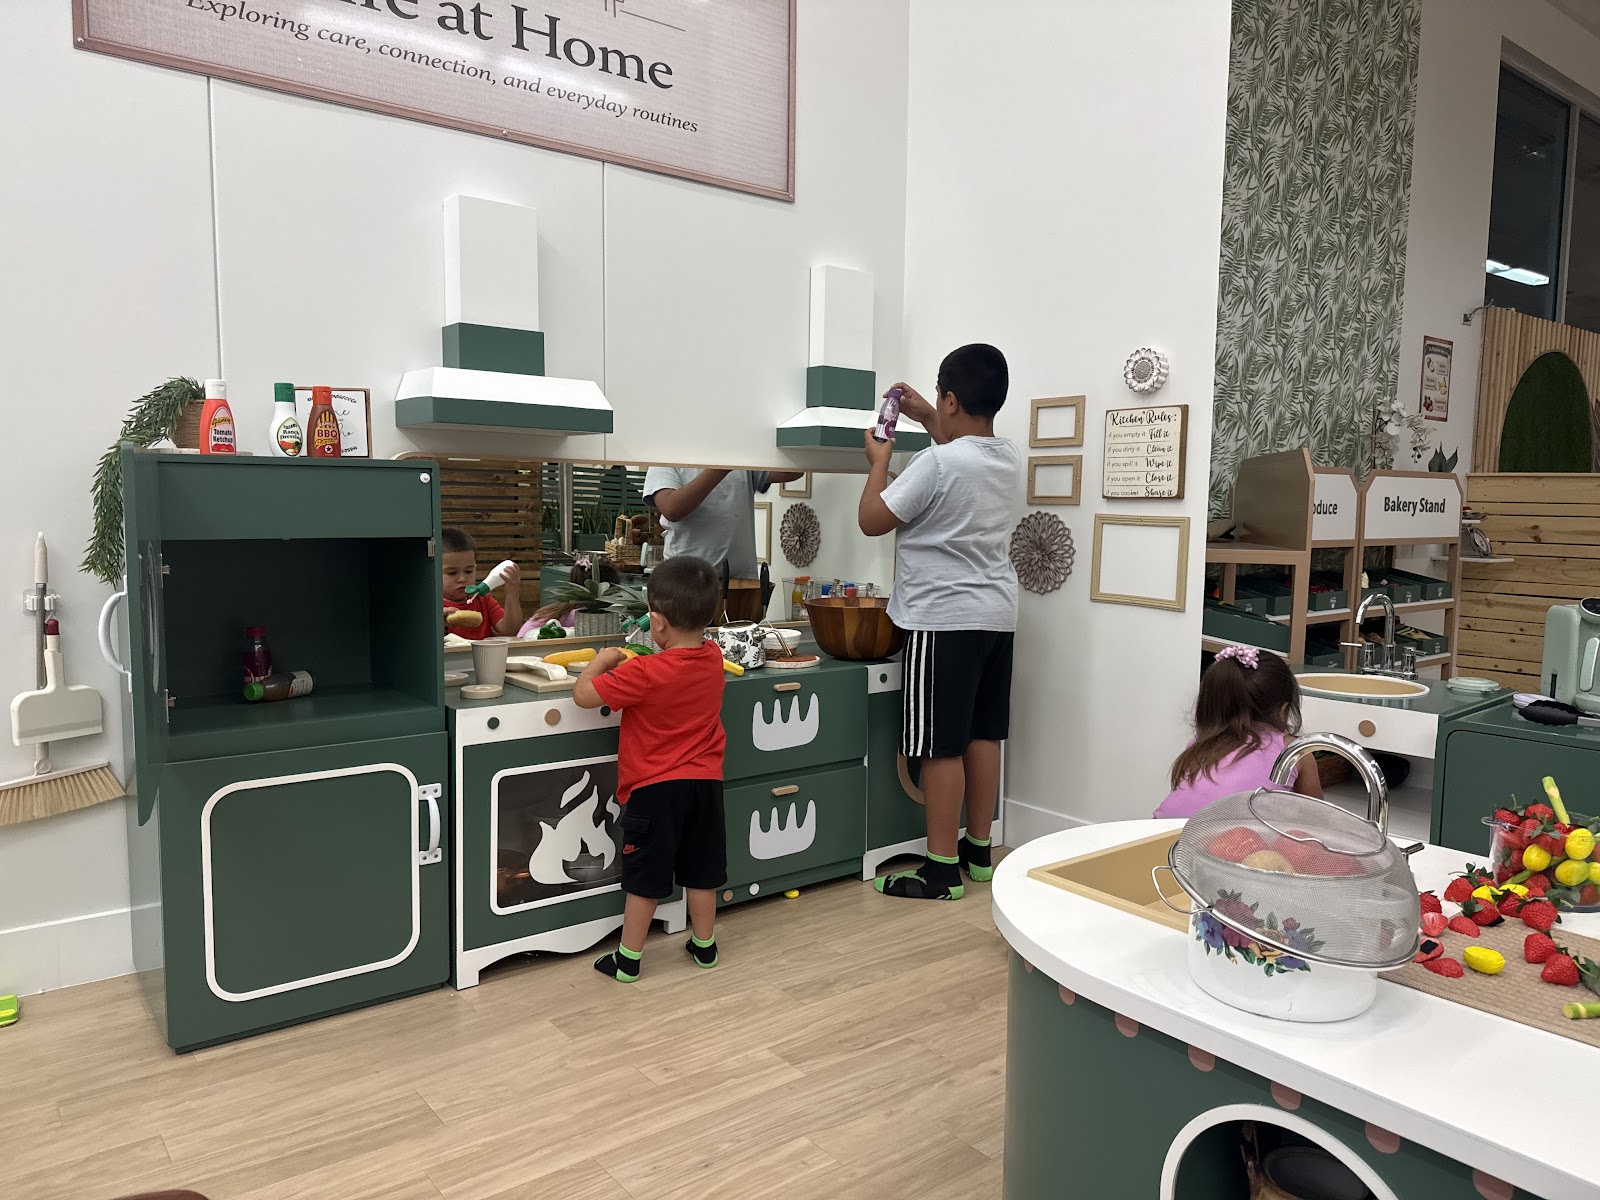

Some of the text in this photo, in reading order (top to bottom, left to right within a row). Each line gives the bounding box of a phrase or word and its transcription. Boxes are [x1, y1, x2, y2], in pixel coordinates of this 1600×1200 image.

[437, 2, 674, 90] at Home
[317, 28, 371, 54] care,
[378, 44, 496, 85] connection,
[503, 76, 542, 94] and
[546, 85, 628, 118] everyday
[632, 106, 698, 133] routines
[1110, 411, 1144, 426] Kitchen
[318, 429, 338, 438] BBQ
[1149, 428, 1162, 440] Fill
[1146, 444, 1165, 454] Clean
[1122, 460, 1133, 468] spill
[1145, 458, 1165, 469] Wipe
[1145, 472, 1165, 484] Close
[1166, 473, 1173, 482] it
[1144, 486, 1165, 497] Share
[1313, 500, 1338, 515] oduce
[1384, 496, 1446, 517] Bakery Stand
